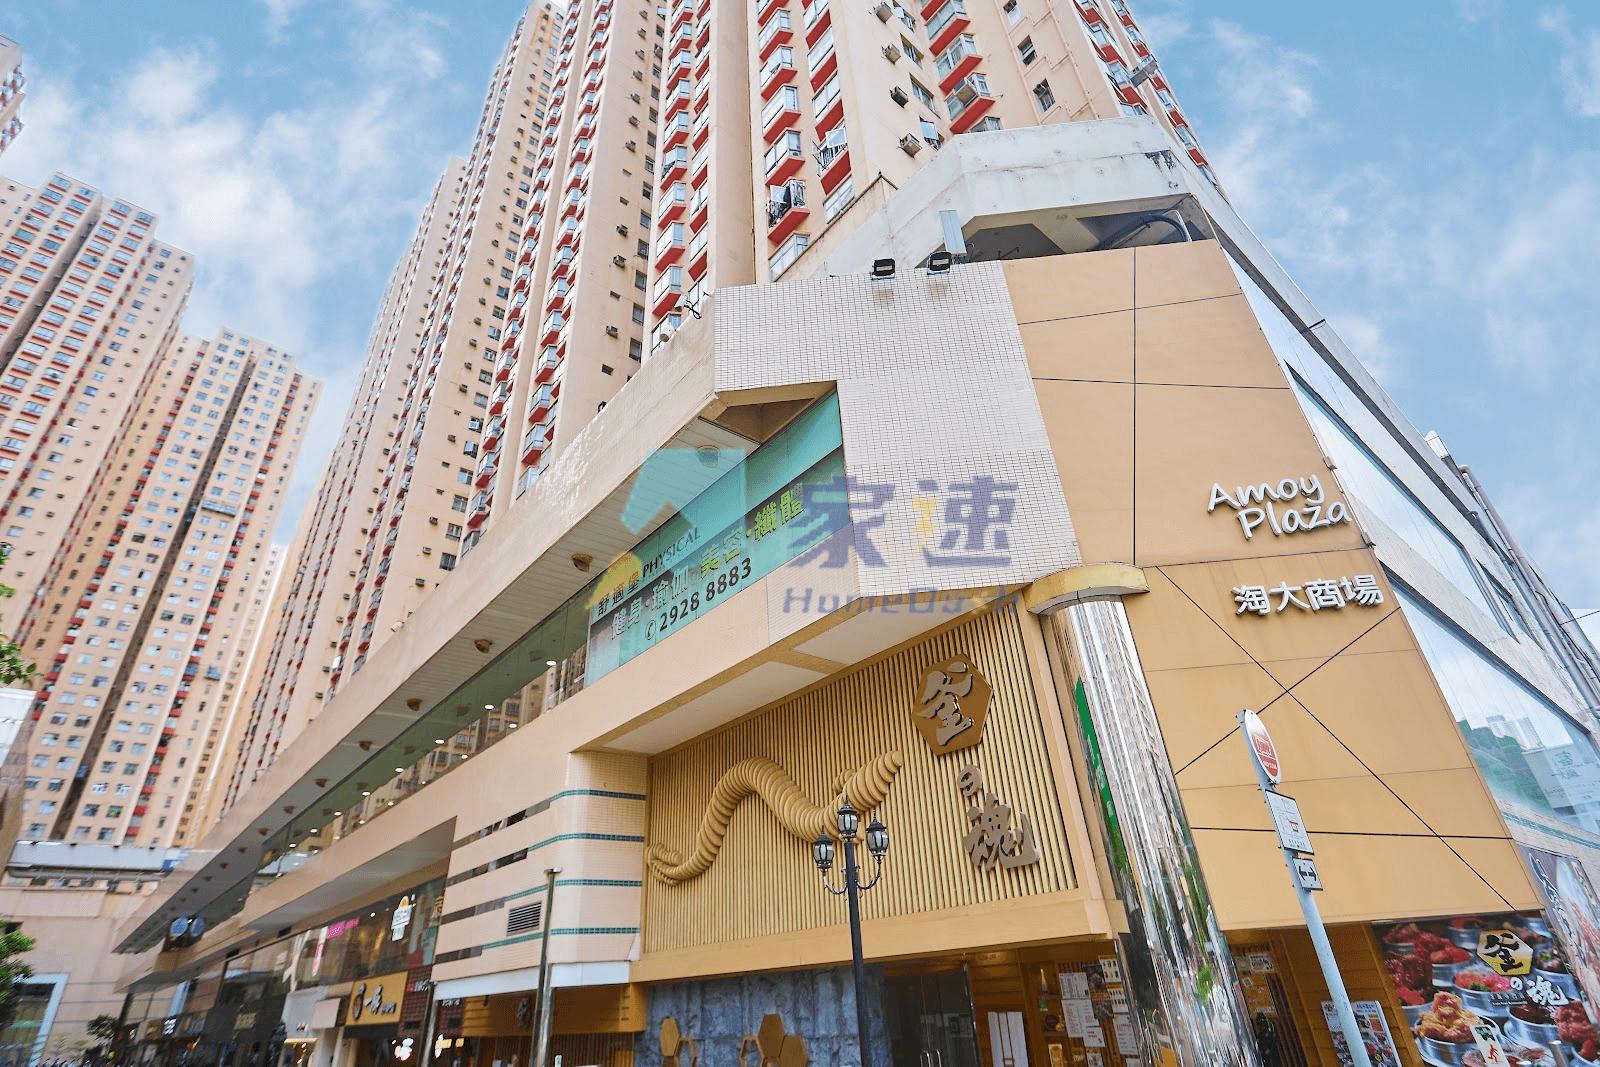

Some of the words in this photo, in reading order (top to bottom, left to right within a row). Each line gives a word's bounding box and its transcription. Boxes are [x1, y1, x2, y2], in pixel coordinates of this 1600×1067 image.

[1207, 474, 1325, 513] Amoy
[1237, 501, 1352, 540] Plaza
[643, 527, 701, 578] PHYSICAL
[659, 591, 700, 632] 2928
[706, 557, 752, 602] 8883
[1231, 574, 1385, 616] 淘大商場
